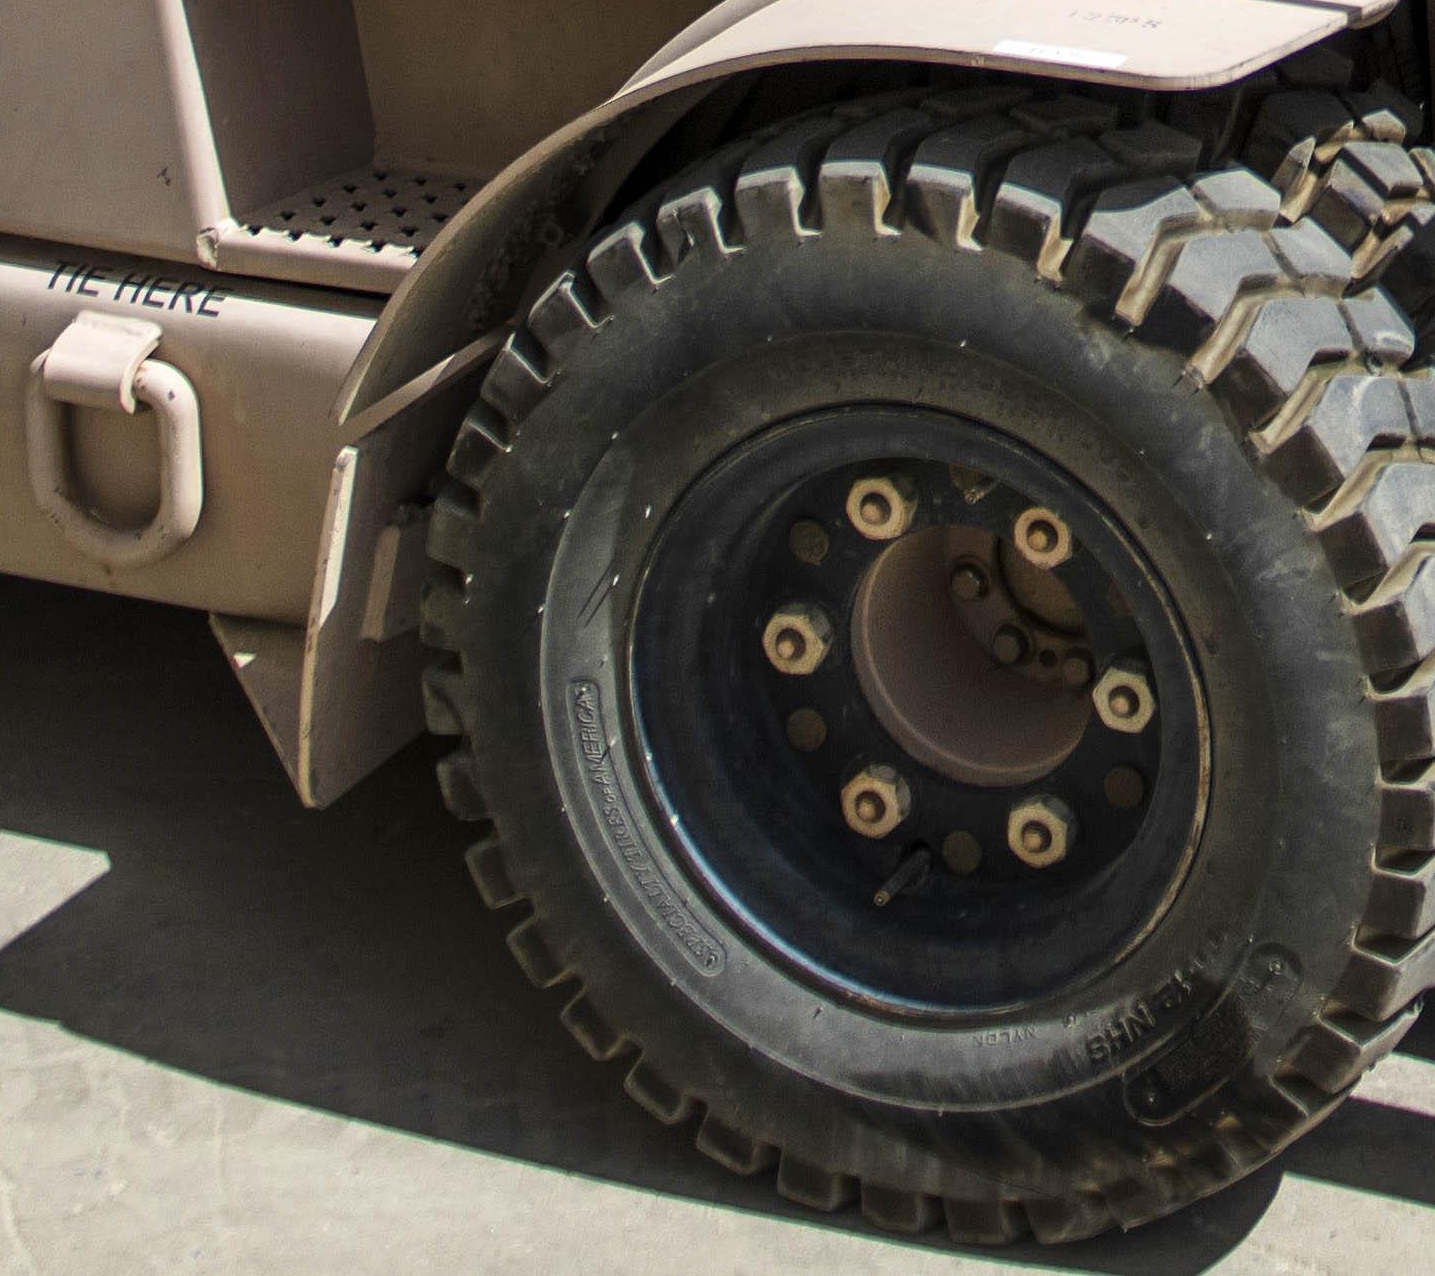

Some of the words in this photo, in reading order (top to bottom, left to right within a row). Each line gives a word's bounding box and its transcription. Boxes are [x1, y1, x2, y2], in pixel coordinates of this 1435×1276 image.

[48, 260, 114, 296] TIE
[113, 272, 236, 318] HERE
[574, 692, 612, 786] AMERICA
